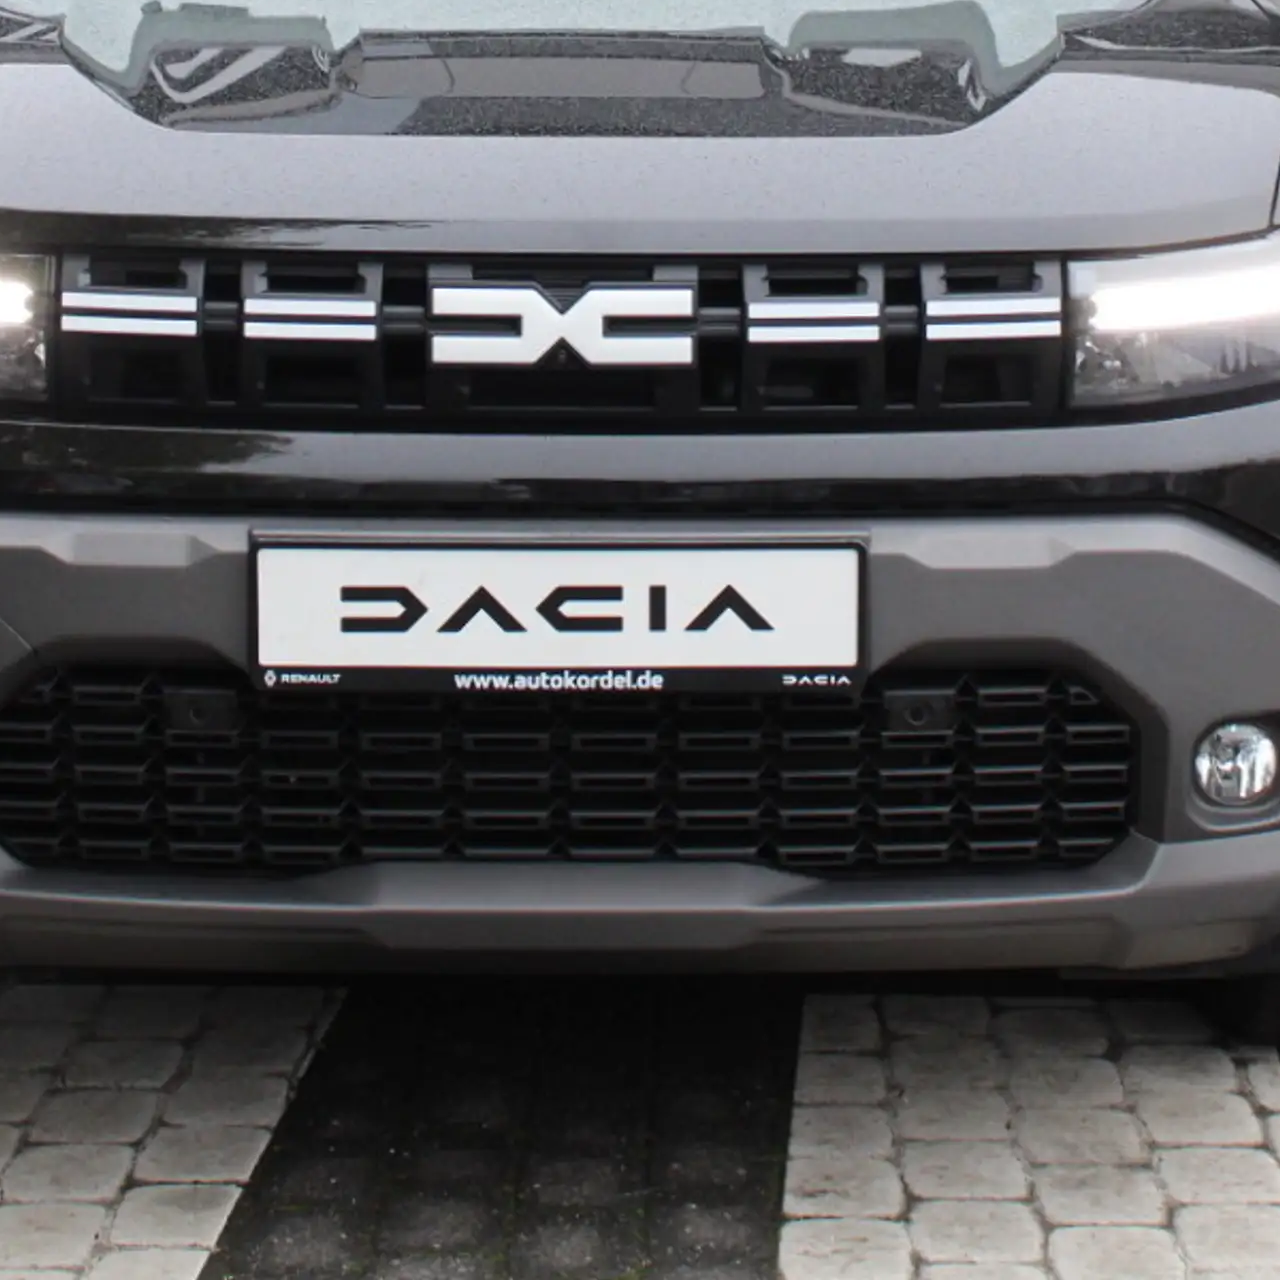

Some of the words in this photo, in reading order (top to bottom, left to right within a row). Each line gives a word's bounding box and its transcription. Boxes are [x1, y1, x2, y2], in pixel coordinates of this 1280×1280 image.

[340, 584, 776, 633] DACIA
[281, 673, 341, 685] RENAULT
[454, 670, 664, 690] www.autokordel.de
[781, 673, 852, 686] DACIA
